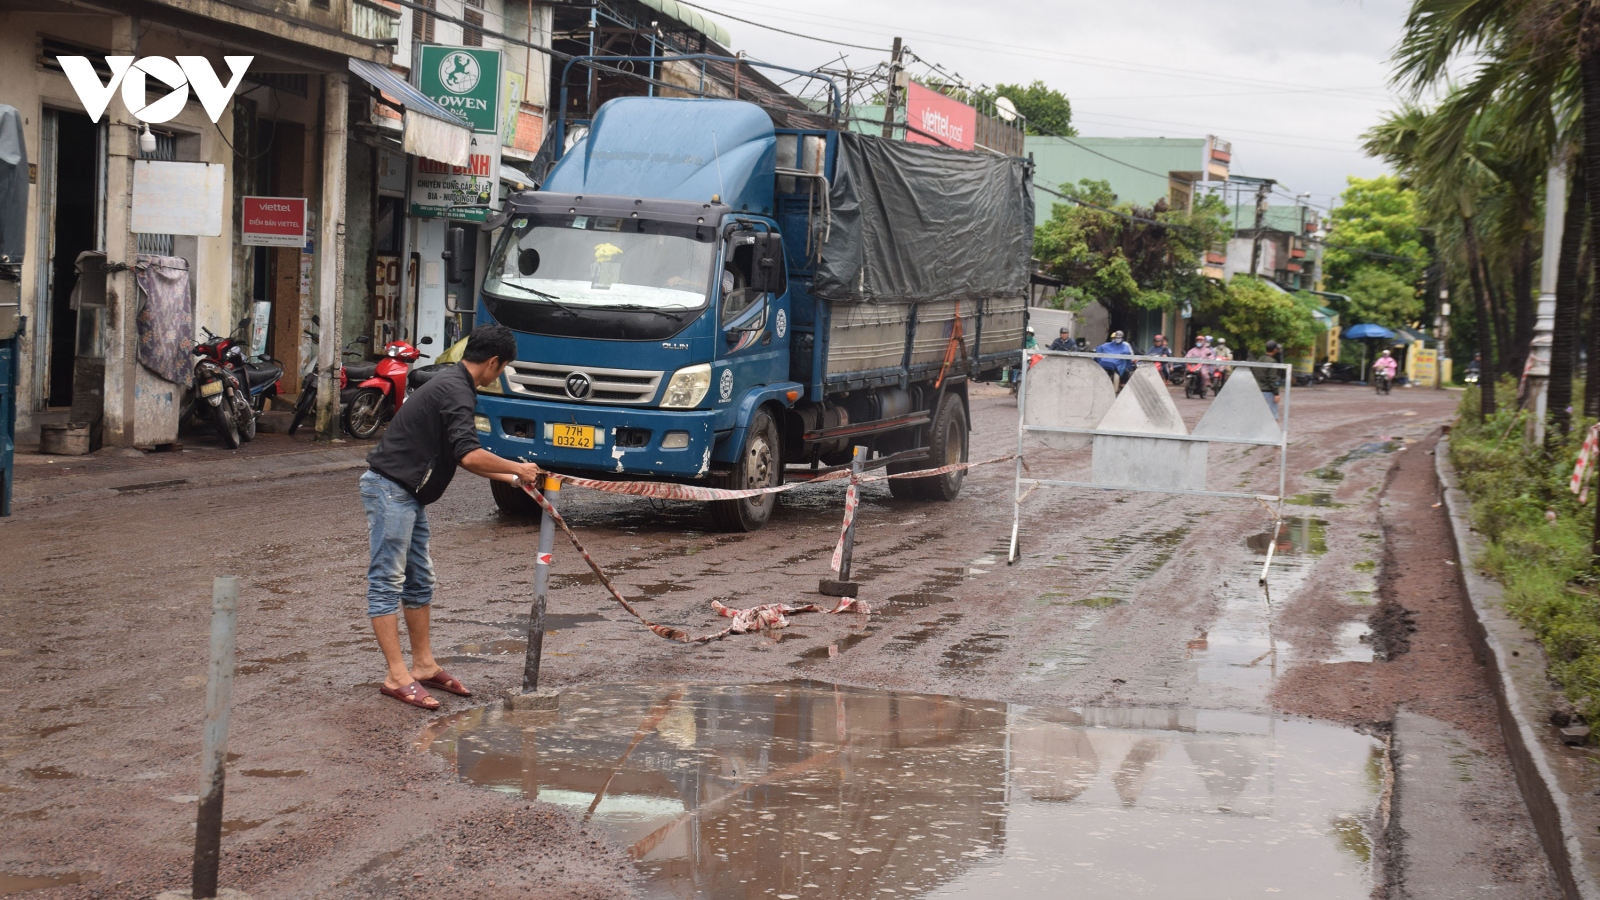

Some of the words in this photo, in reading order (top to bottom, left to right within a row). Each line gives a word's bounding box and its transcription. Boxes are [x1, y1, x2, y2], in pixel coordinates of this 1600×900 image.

[921, 107, 949, 138] viettel
[949, 124, 963, 143] post
[427, 192, 438, 200] BIA
[258, 203, 291, 212] viettel
[264, 218, 276, 226] BÁN
[662, 342, 689, 350] OLLIN
[565, 425, 583, 436] 77H
[557, 436, 590, 448] 032.42
